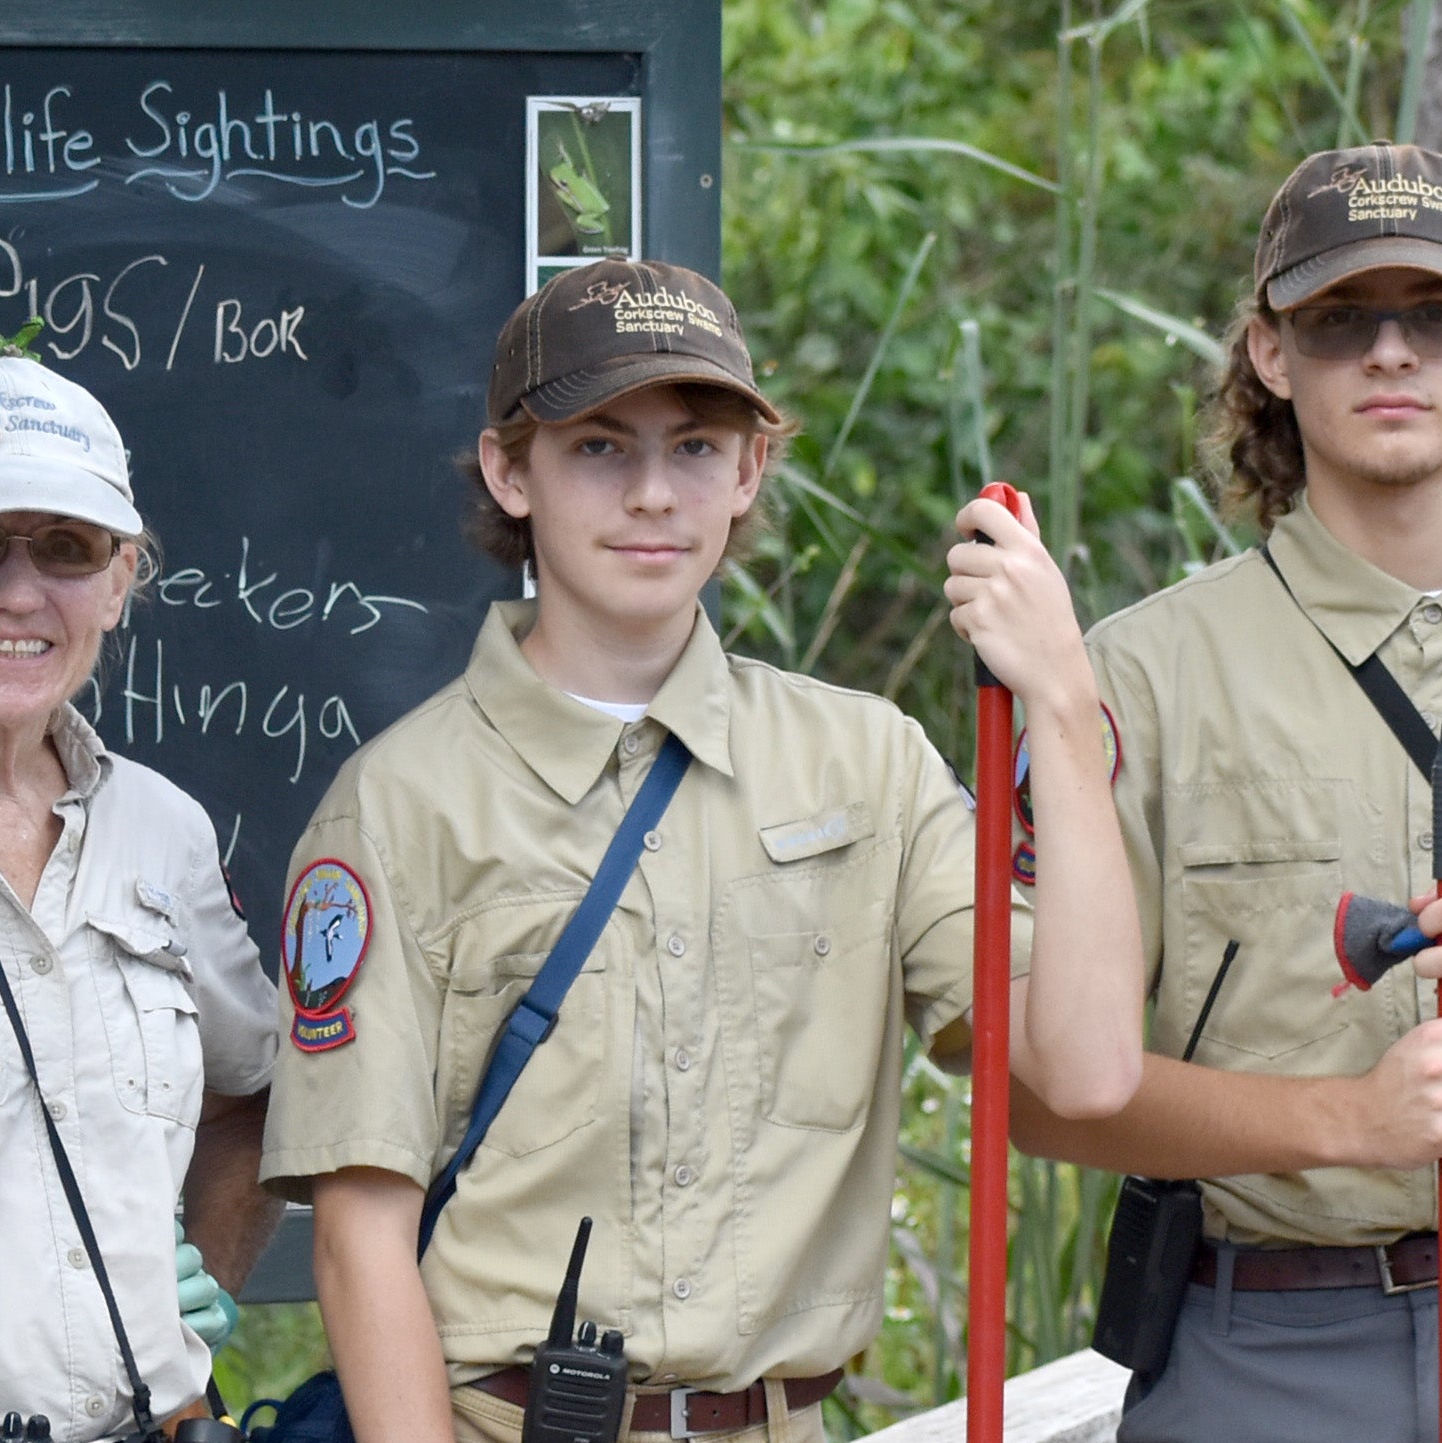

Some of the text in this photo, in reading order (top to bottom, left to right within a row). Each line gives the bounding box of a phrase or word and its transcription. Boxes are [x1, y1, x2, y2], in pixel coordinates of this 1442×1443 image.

[125, 80, 421, 208] Sightings
[1348, 194, 1419, 209] Corkscrew
[1347, 206, 1418, 222] Sanctuary
[613, 286, 720, 325] Audubon
[614, 307, 685, 322] Corkscrew
[615, 321, 685, 336] Sanctuary
[4, 415, 91, 454] Sanctuary
[562, 1368, 611, 1380] MOTOROLA
